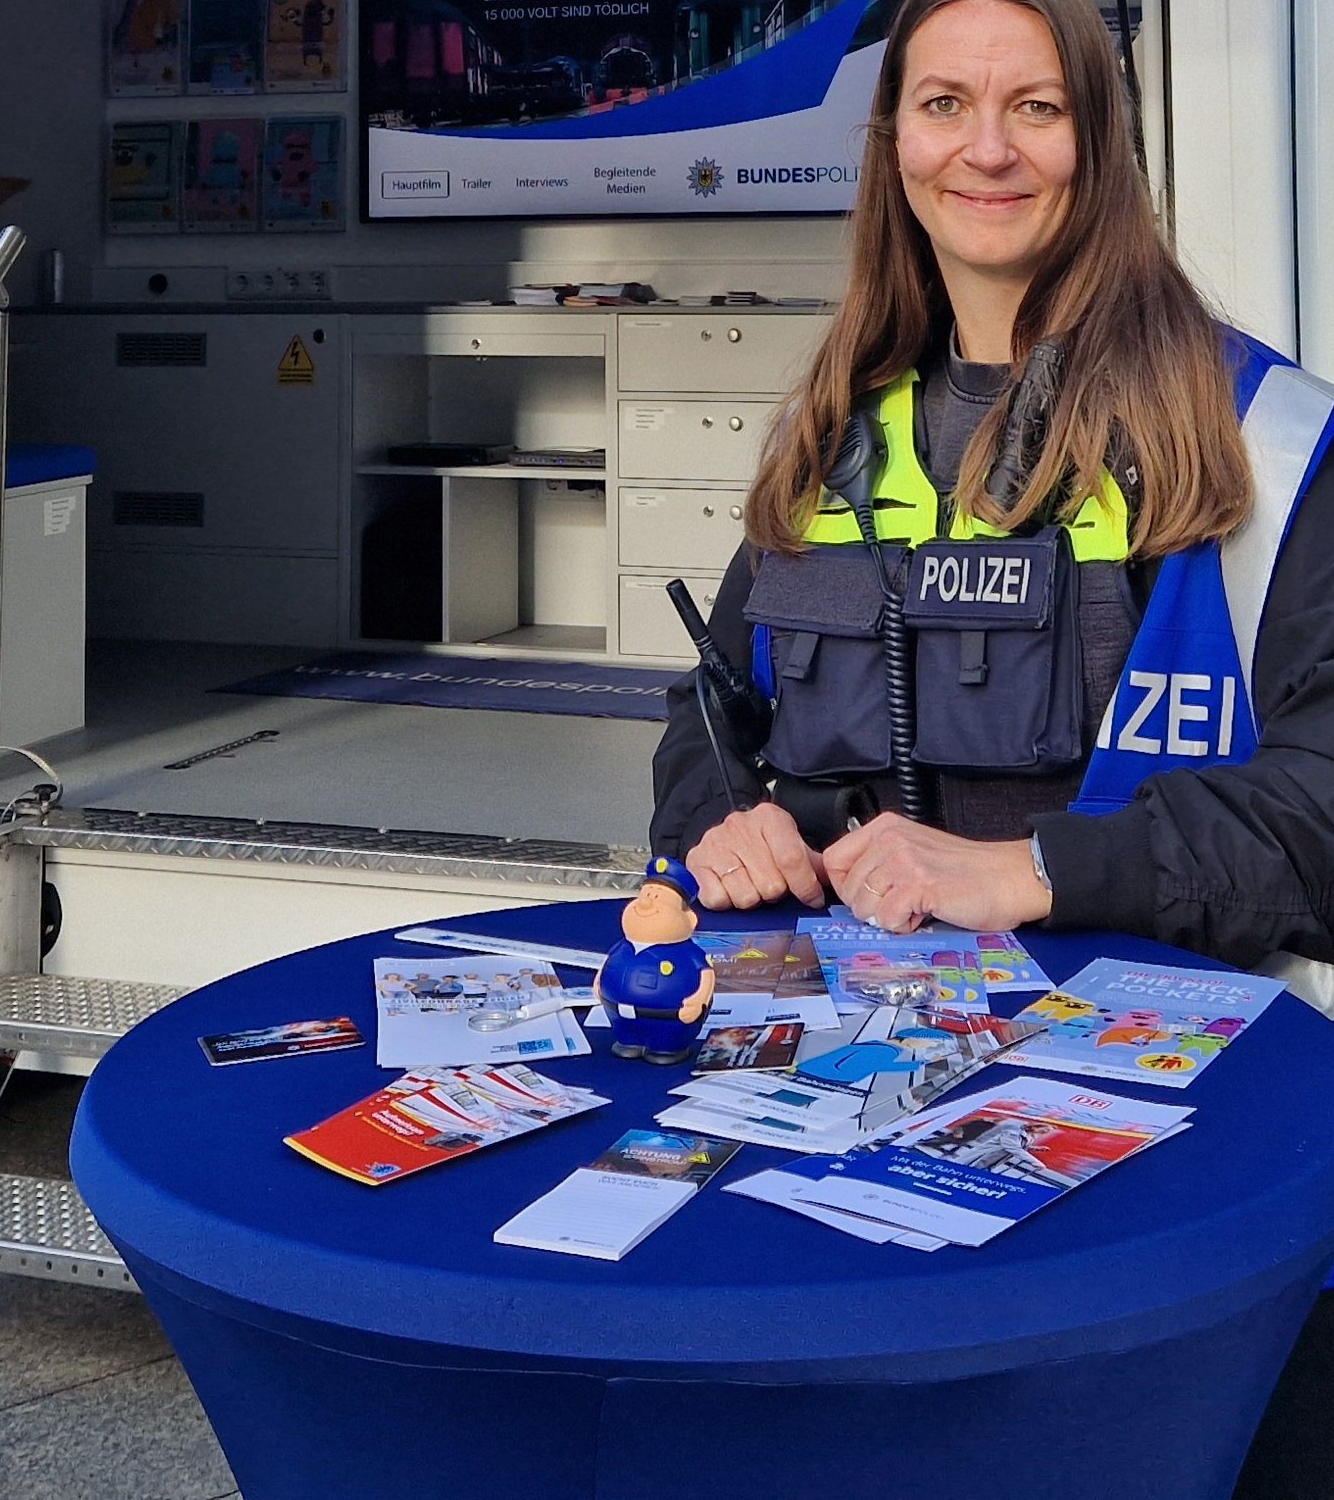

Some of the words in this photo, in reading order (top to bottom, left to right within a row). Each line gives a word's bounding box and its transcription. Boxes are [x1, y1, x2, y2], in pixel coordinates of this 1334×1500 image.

[484, 10, 497, 21] 15
[500, 8, 525, 21] 000
[527, 5, 559, 19] VOLT
[561, 4, 591, 18] SIND
[594, 1, 650, 17] TÖDLICH
[593, 166, 657, 181] Begleitende
[736, 166, 861, 185] BUNDESPOLI
[391, 179, 442, 194] Hauptfilm
[461, 177, 492, 190] Trailer
[515, 175, 569, 189] Interviews
[605, 182, 647, 196] Medien
[919, 556, 1031, 604] POLIZEI
[293, 663, 668, 699] www.bundespoli
[813, 933, 890, 941] DIEBE
[1118, 974, 1172, 989] THE
[1105, 981, 1239, 1005] POCKETS
[1072, 1096, 1109, 1108] DB
[619, 1148, 682, 1161] ACHTUNG
[932, 1164, 964, 1177] Bahn
[887, 1164, 936, 1181] aber
[935, 1176, 1008, 1199] sicher!
